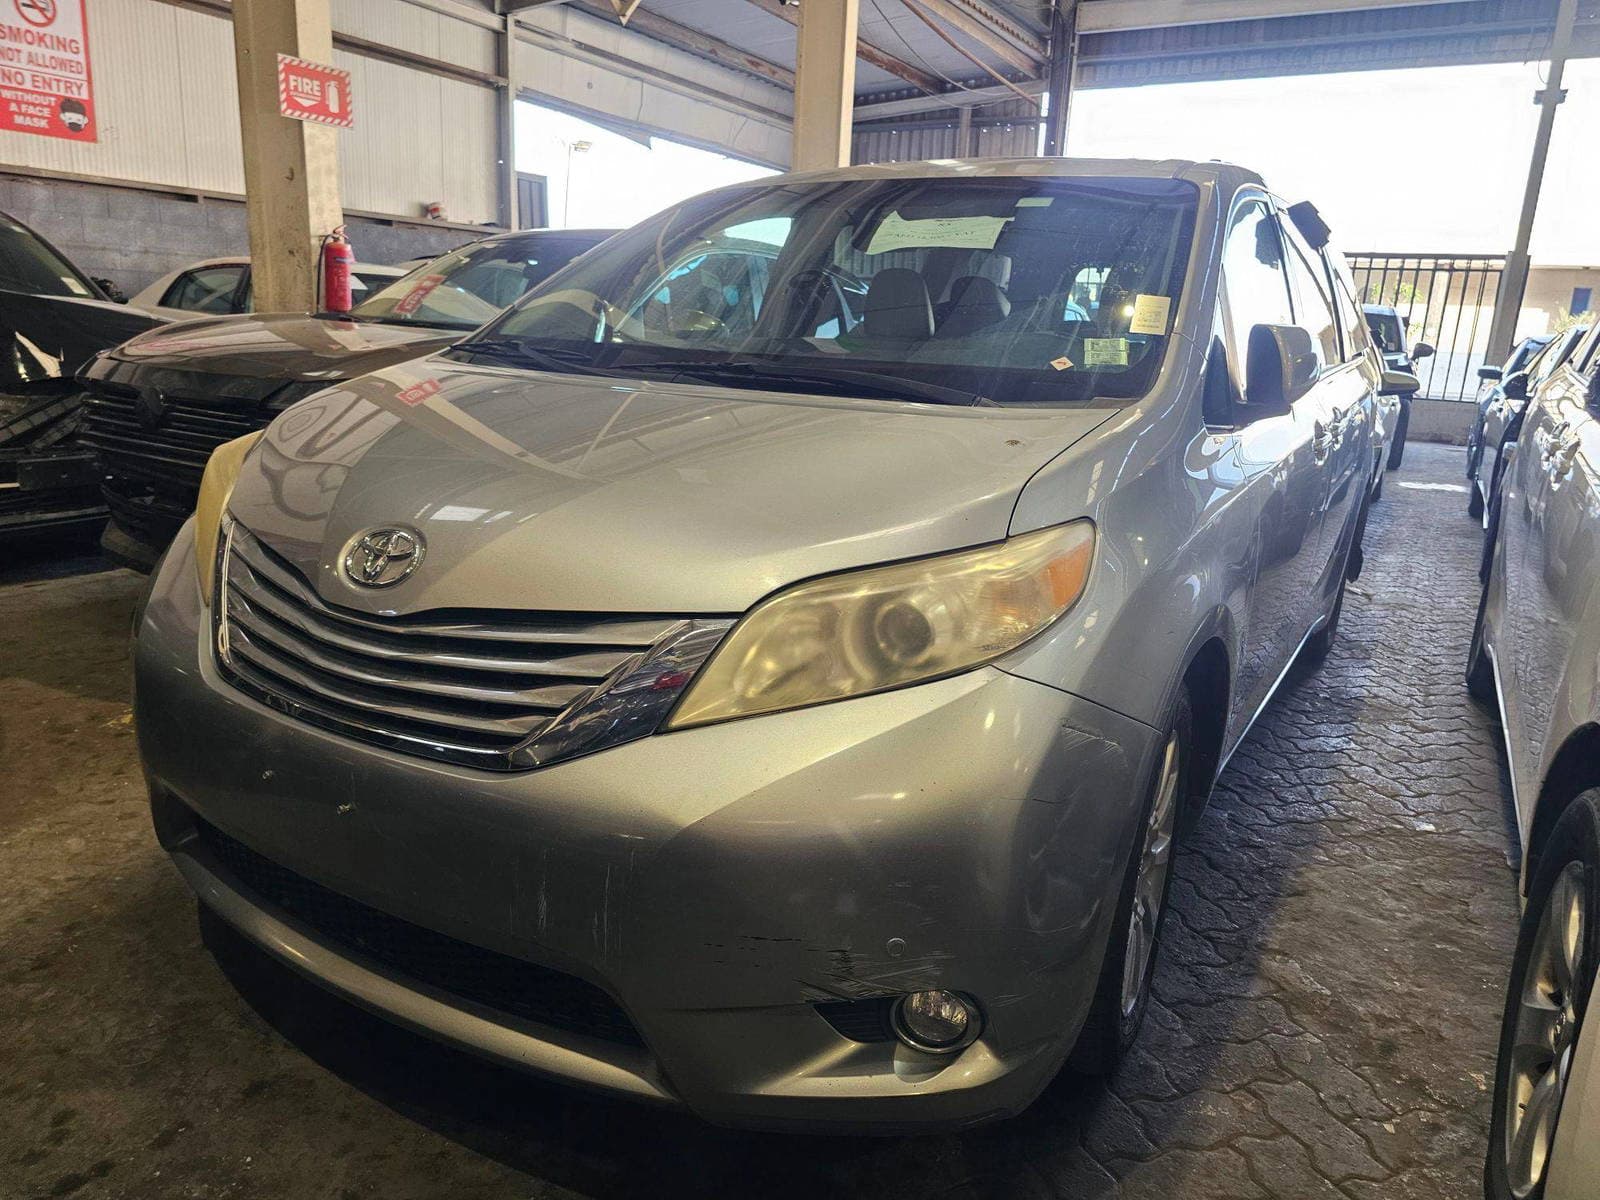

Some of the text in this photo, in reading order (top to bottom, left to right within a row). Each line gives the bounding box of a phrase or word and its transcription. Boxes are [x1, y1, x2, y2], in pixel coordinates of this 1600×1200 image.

[0, 24, 80, 54] SMOKING
[0, 47, 83, 74] NOT ALLOWED
[1, 68, 83, 96] NO ENTRY
[288, 74, 322, 96] FIRE
[1, 88, 56, 106] WITHOUT
[9, 102, 51, 118] A FACE
[14, 115, 49, 128] MASK
